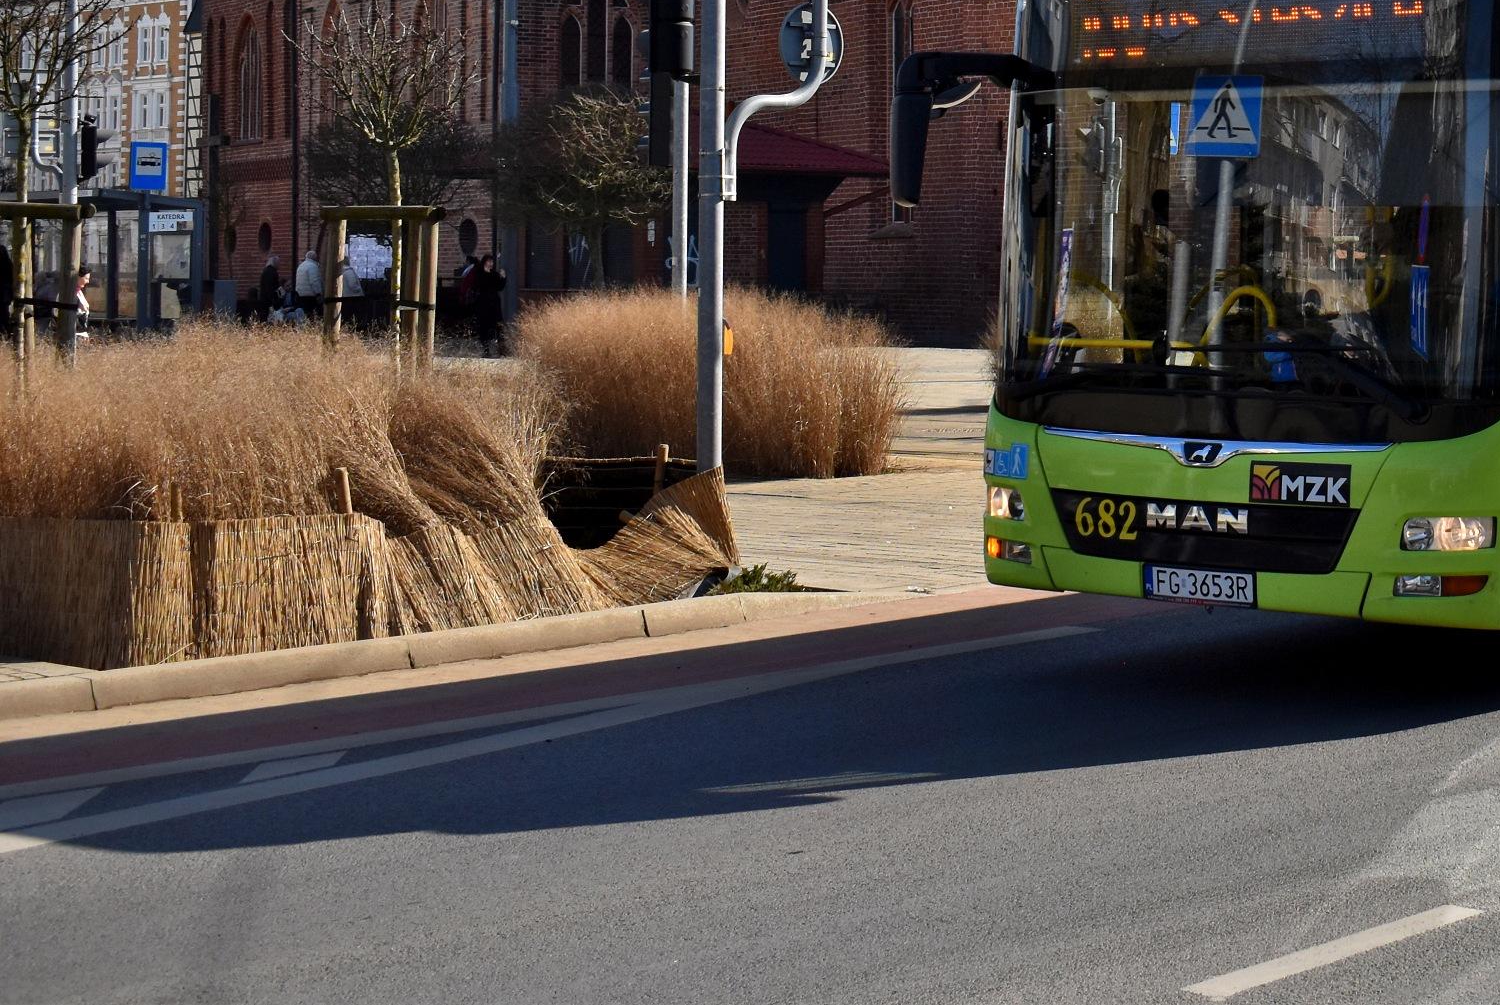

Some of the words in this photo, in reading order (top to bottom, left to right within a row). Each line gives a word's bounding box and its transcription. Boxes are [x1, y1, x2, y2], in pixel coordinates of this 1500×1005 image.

[1280, 474, 1348, 504] MZK
[1075, 497, 1139, 540] 682
[1146, 503, 1249, 534] MAN
[1156, 569, 1180, 595] FG
[1187, 572, 1249, 601] 3653R
